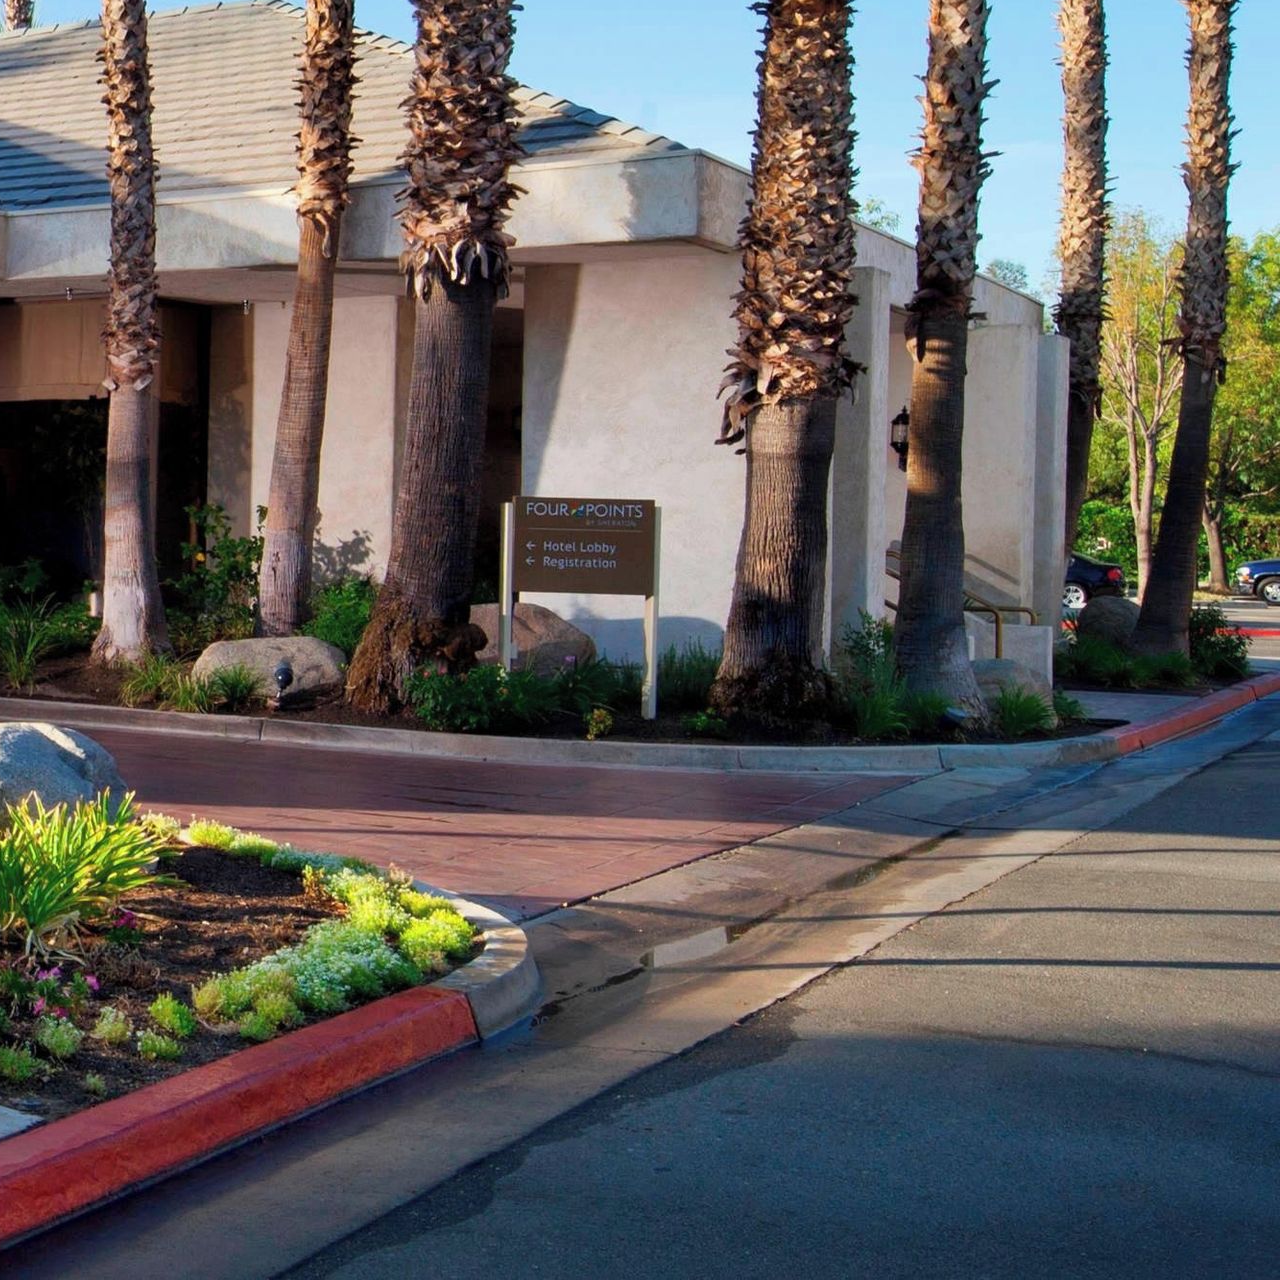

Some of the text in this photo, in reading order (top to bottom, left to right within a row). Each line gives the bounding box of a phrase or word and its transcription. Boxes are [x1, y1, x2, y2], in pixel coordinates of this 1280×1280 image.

[526, 502, 643, 518] FOUR POINTS
[543, 541, 617, 555] Hotel Lobby
[543, 556, 617, 569] Registration
